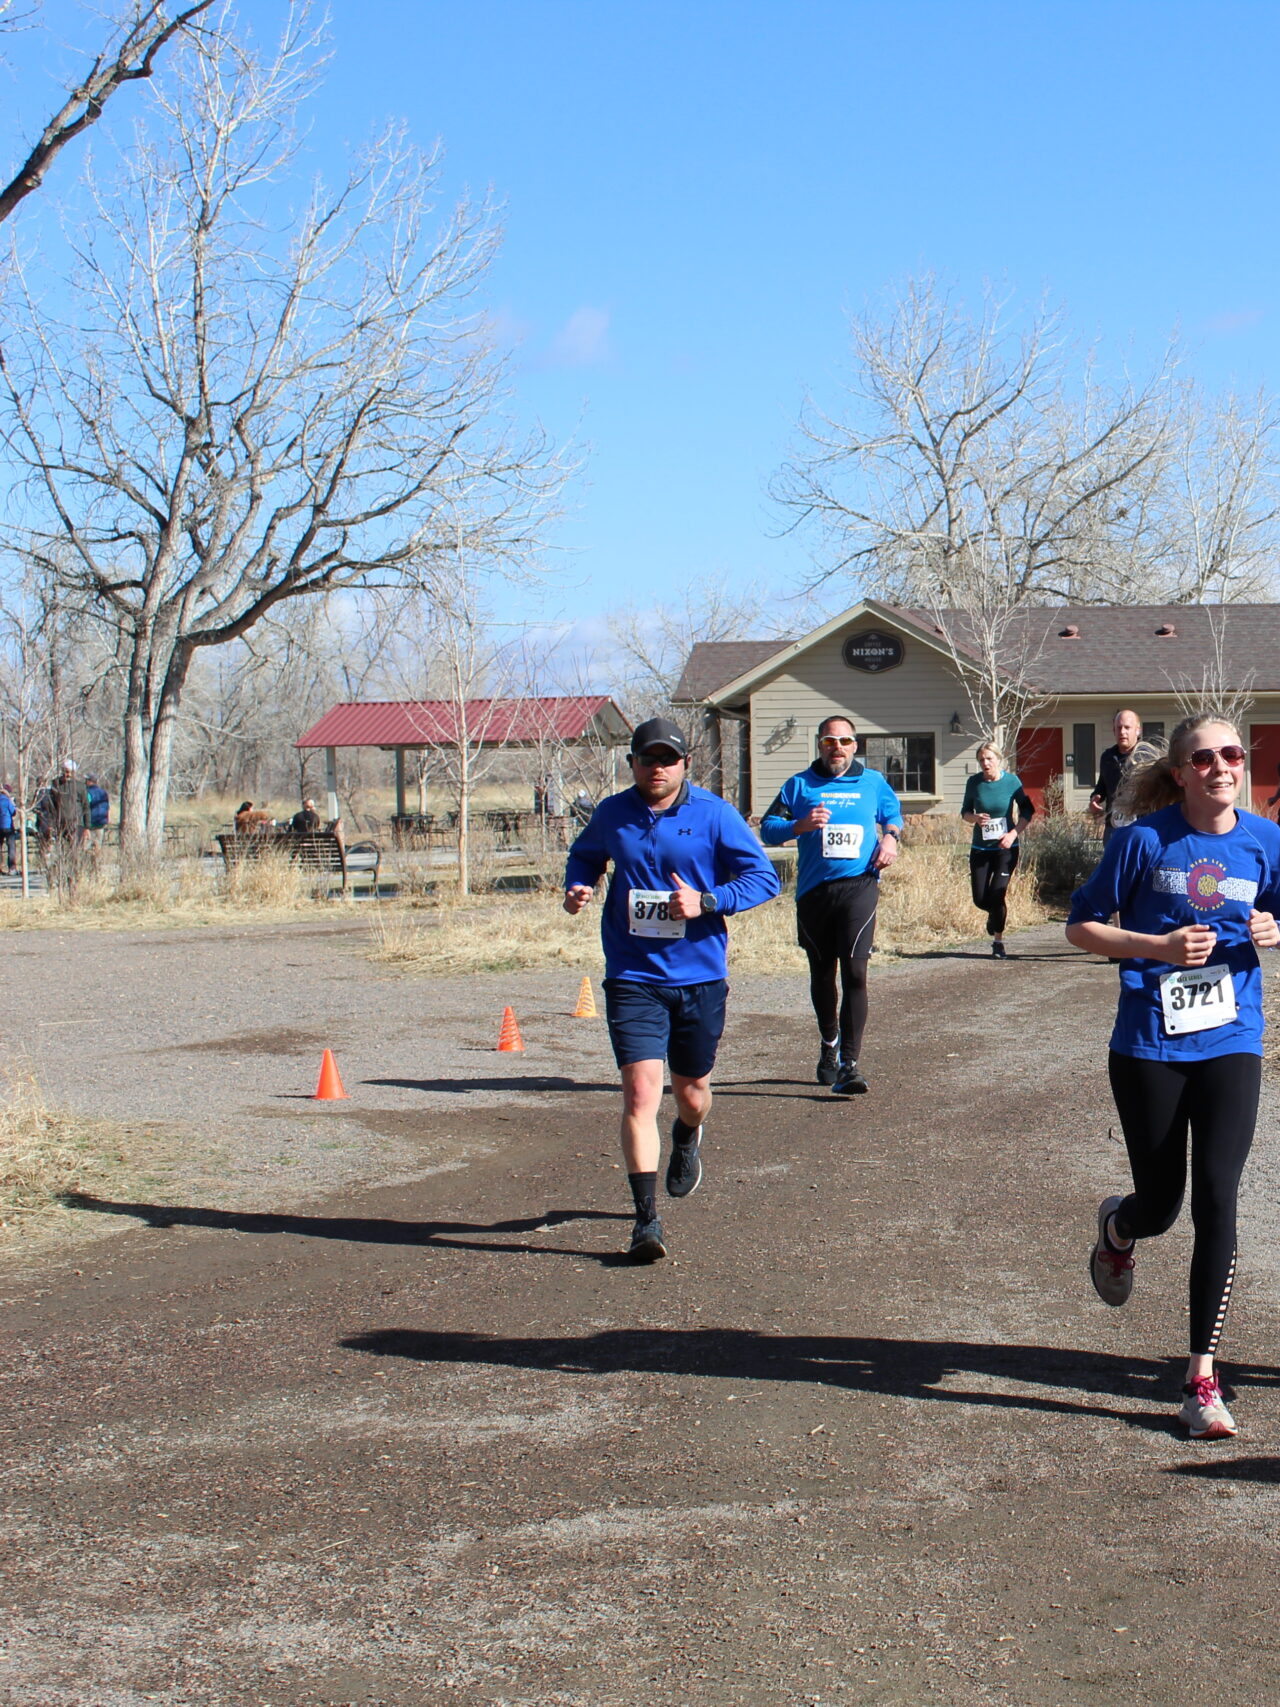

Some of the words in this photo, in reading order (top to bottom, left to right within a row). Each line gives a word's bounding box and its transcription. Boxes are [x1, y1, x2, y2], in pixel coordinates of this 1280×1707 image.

[852, 648, 895, 656] NIXON'S
[985, 822, 1003, 832] 3411
[827, 832, 858, 846] 3347
[634, 900, 678, 921] 378
[1187, 899, 1208, 912] CANAL
[1170, 980, 1224, 1011] 3721
